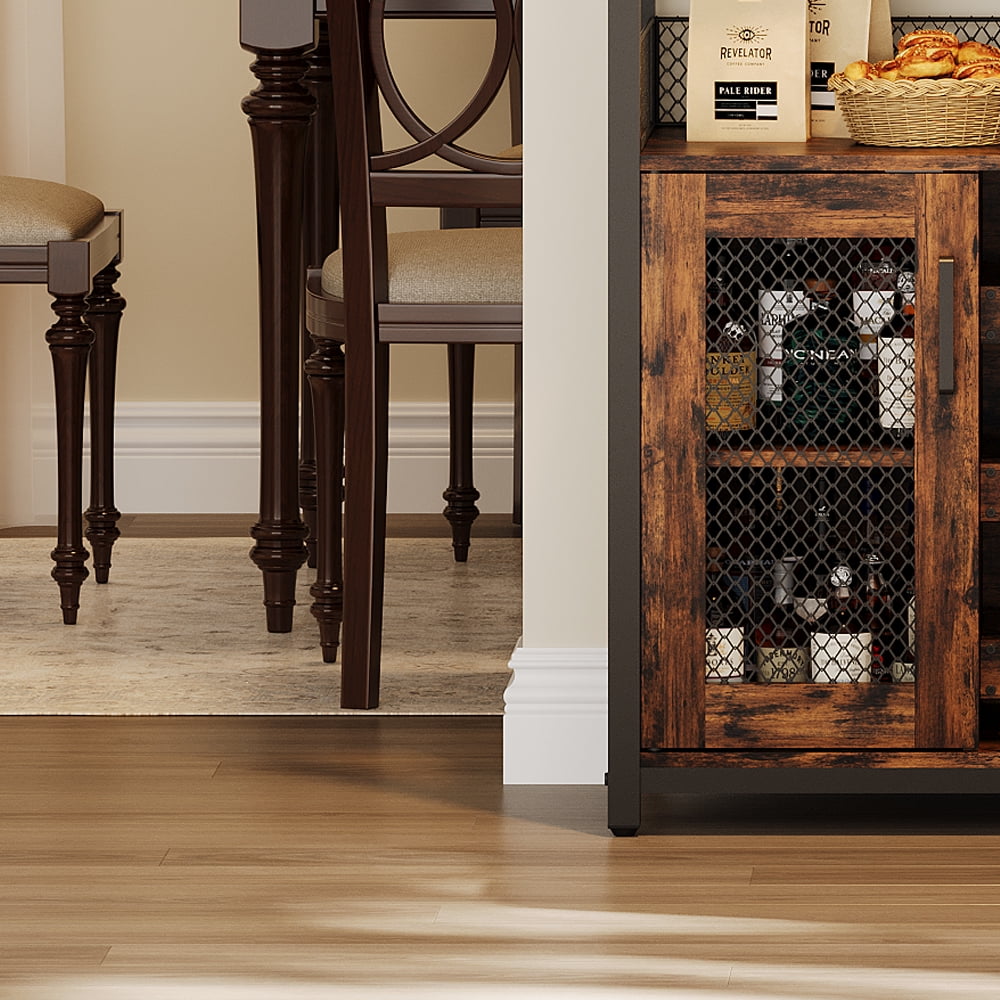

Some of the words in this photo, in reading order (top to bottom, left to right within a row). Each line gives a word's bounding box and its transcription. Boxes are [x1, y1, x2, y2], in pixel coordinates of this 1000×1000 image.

[720, 46, 772, 61] REVELATOR
[719, 86, 741, 95] PALE
[744, 86, 772, 95] RIDER
